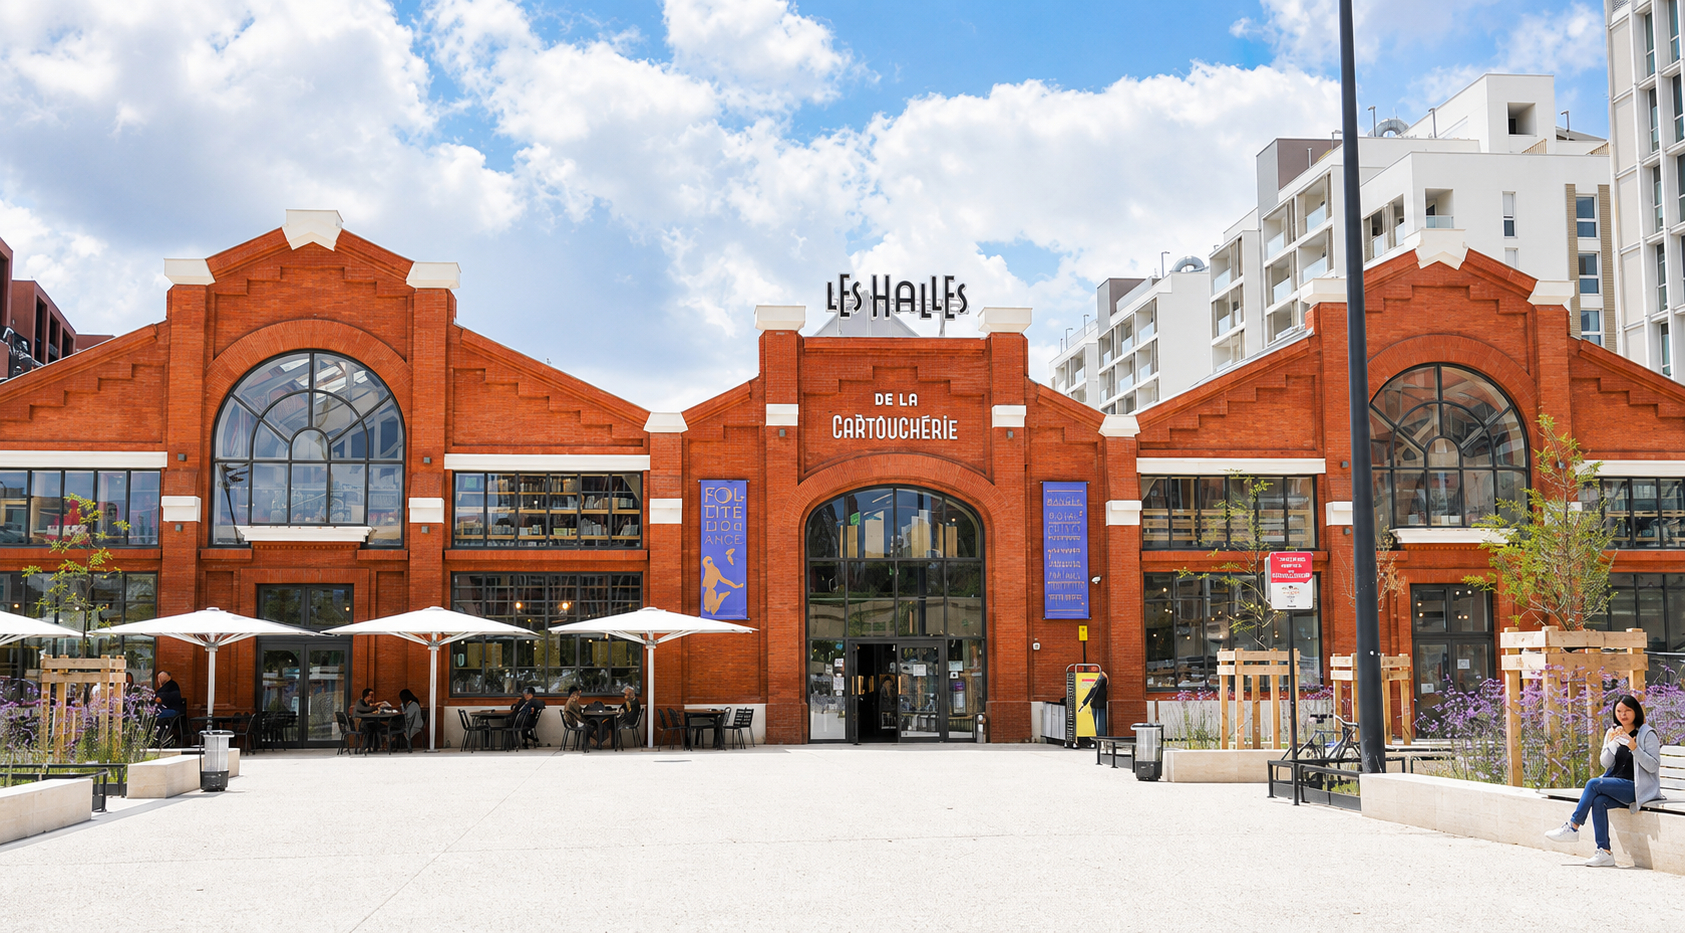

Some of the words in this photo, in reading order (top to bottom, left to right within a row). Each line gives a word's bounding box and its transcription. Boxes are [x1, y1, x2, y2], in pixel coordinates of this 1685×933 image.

[826, 273, 863, 318] LES
[870, 273, 969, 320] HALLES
[874, 392, 894, 406] DE
[899, 393, 918, 407] LA
